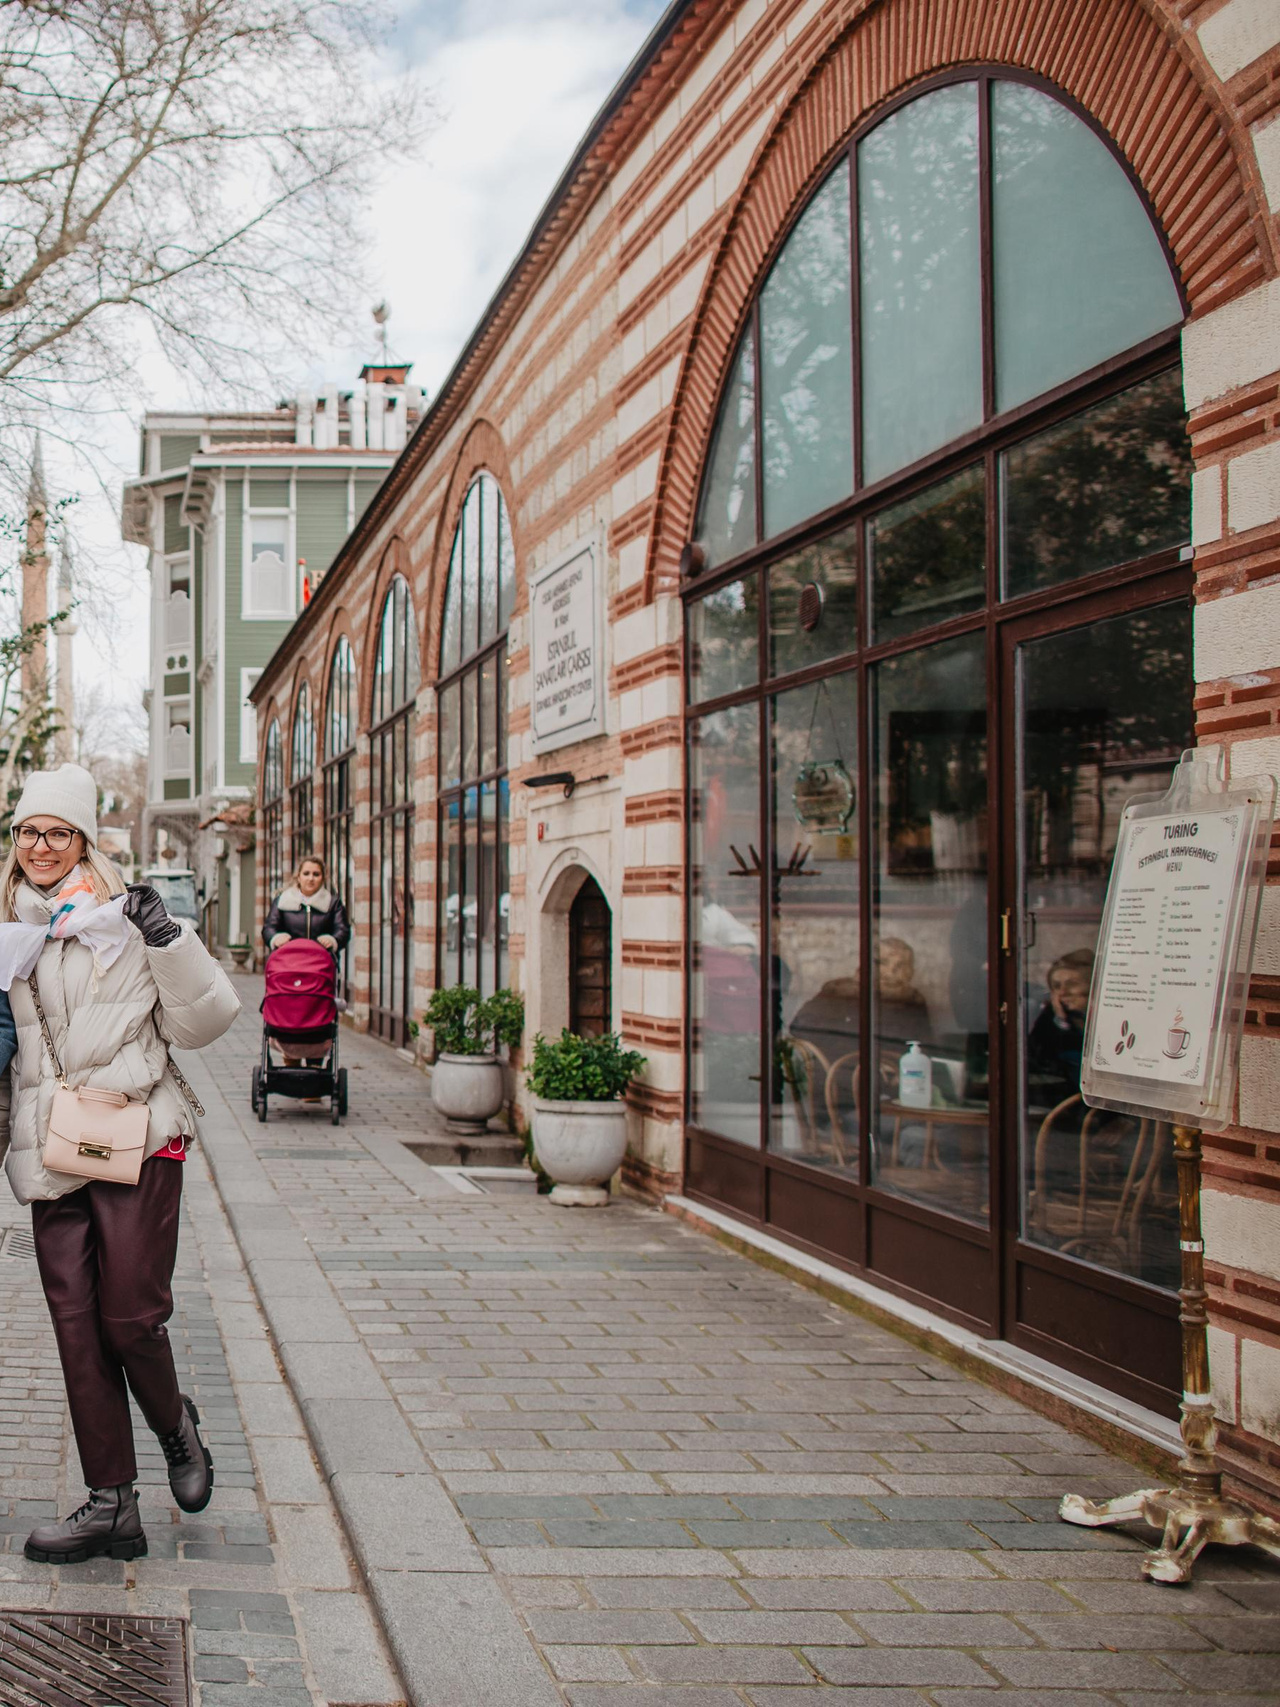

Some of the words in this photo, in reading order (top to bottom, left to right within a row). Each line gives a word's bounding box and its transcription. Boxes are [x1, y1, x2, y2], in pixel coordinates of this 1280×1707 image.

[1163, 820, 1199, 840] TURİNG
[1138, 848, 1169, 869] İSTANBUL
[1170, 846, 1219, 864] KAHVEHANESİ
